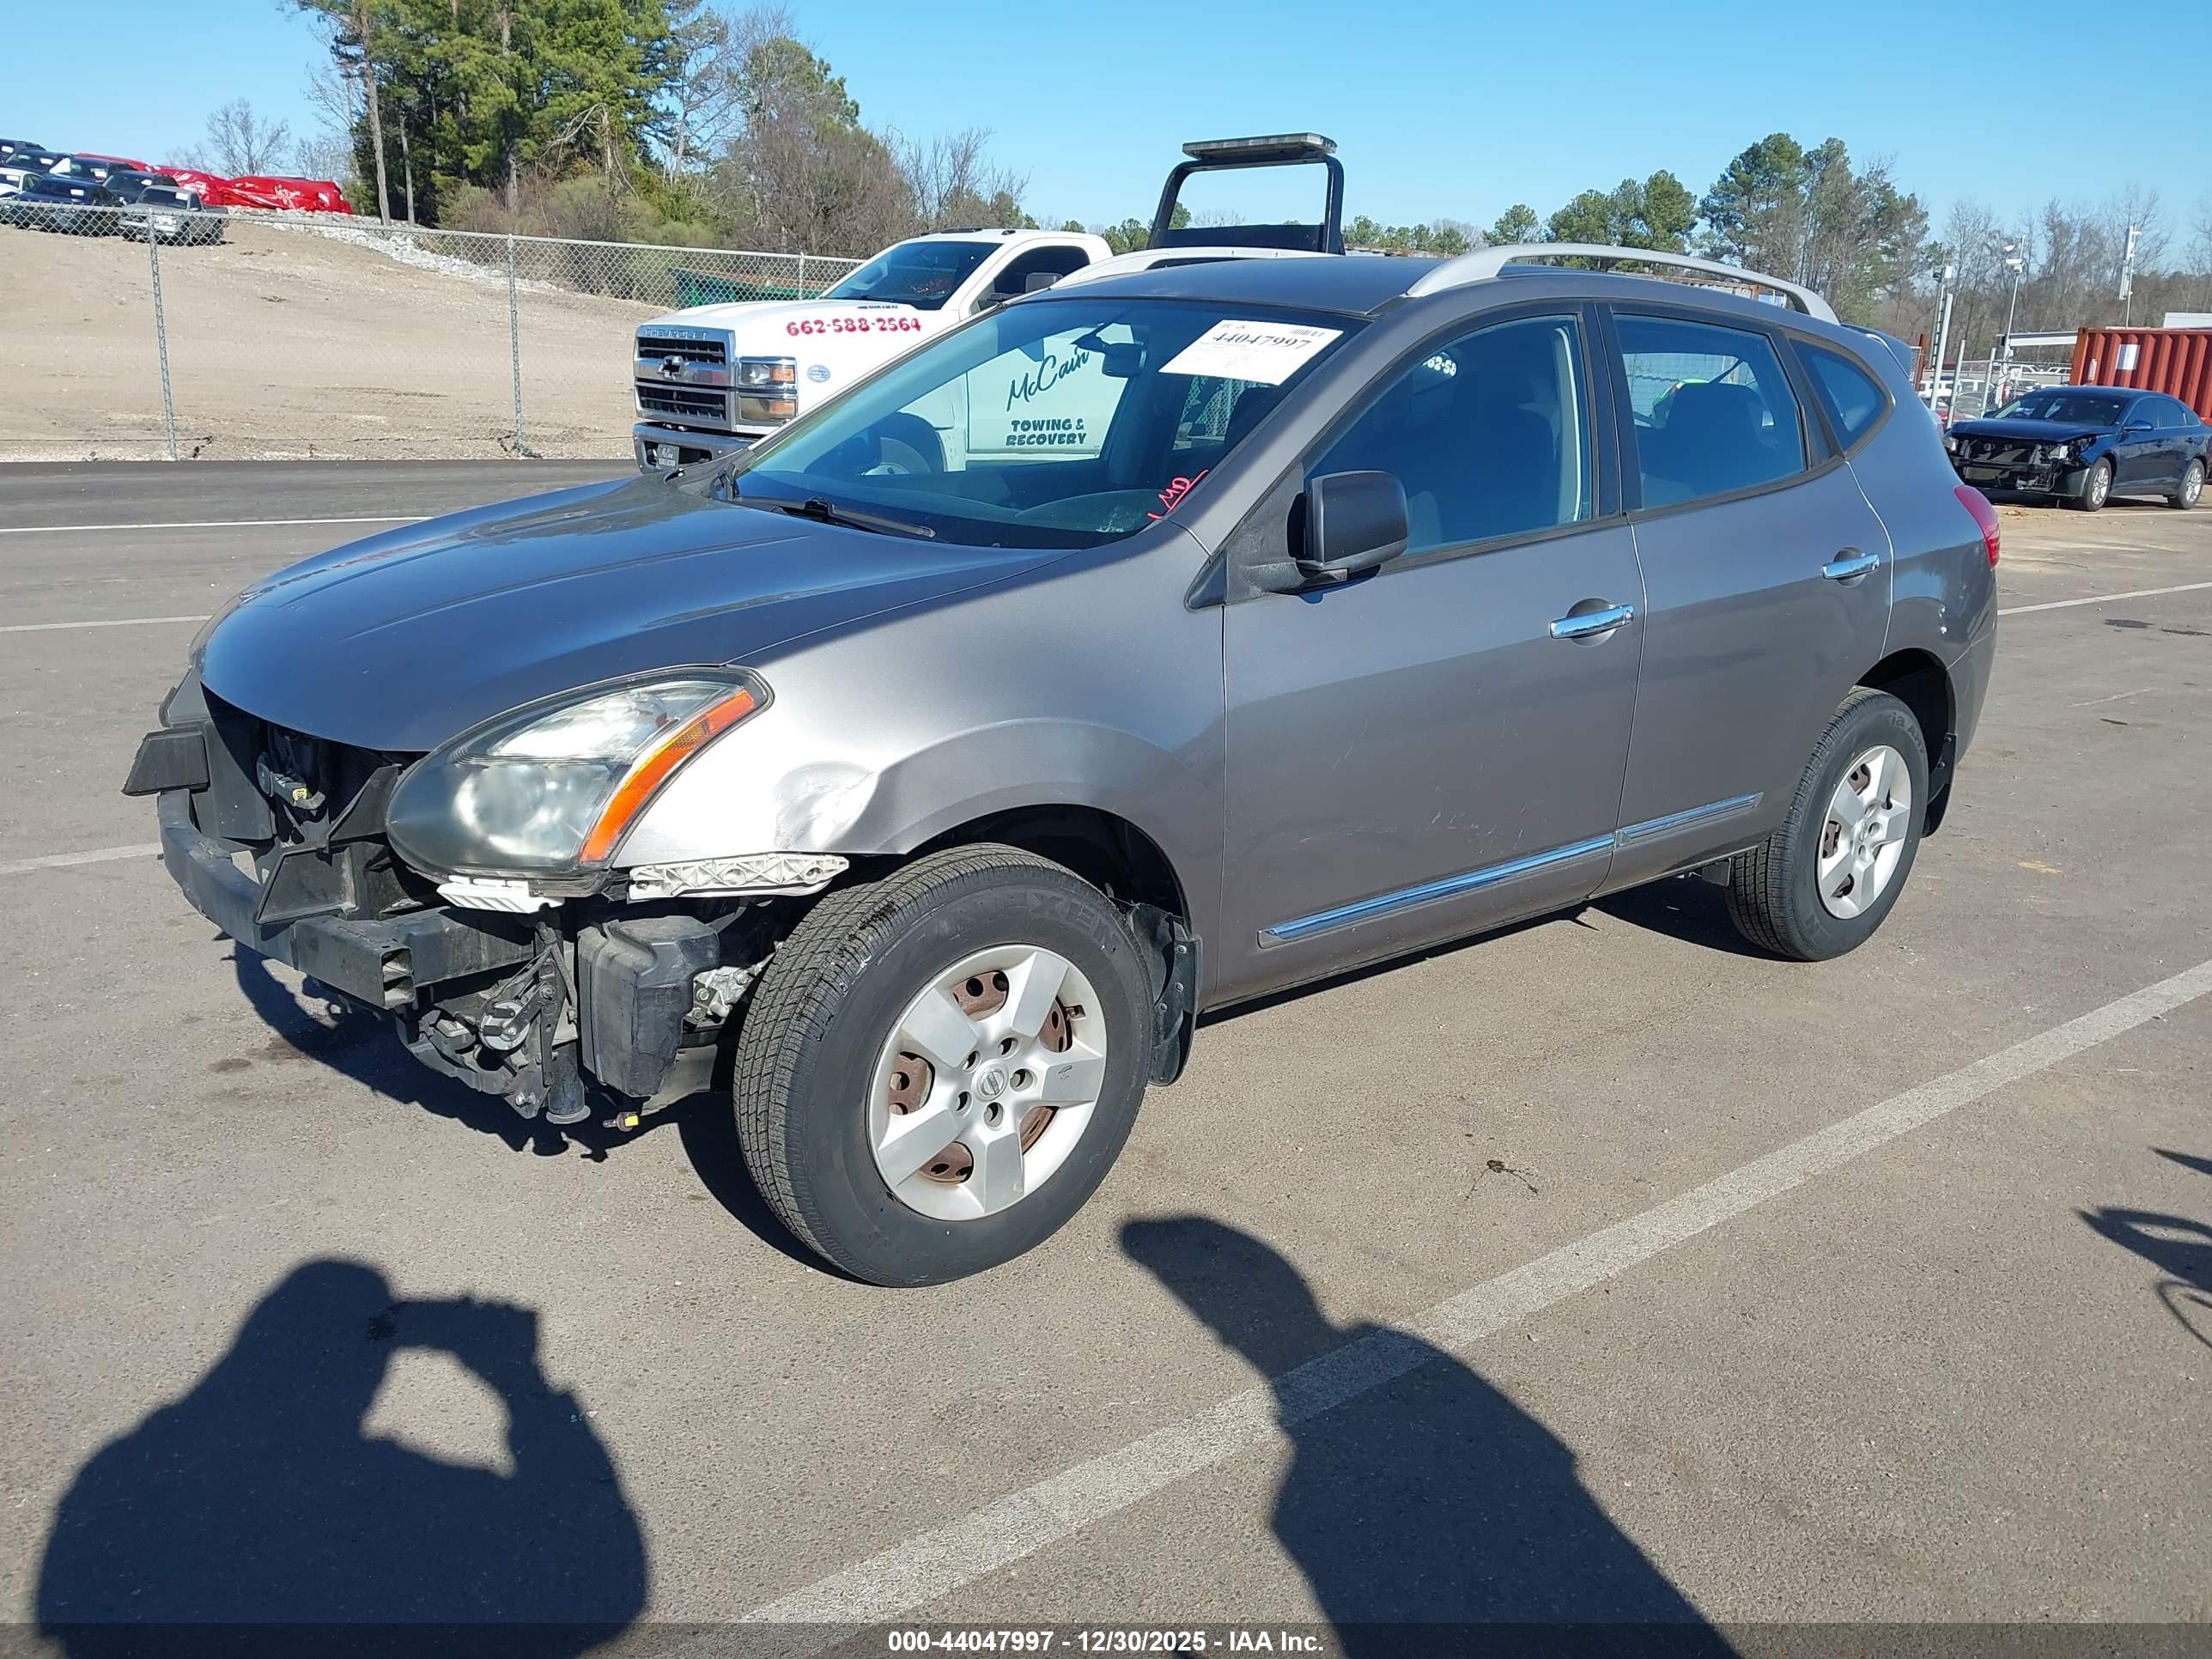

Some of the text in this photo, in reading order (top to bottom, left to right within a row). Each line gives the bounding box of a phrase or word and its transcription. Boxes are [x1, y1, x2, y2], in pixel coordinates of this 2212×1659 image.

[645, 329, 708, 340] CHEVROLET
[1212, 332, 1312, 349] 44047997
[1006, 347, 1091, 412] McCain
[1011, 418, 1085, 432] TOWING &
[1006, 433, 1087, 446] RECOVERY
